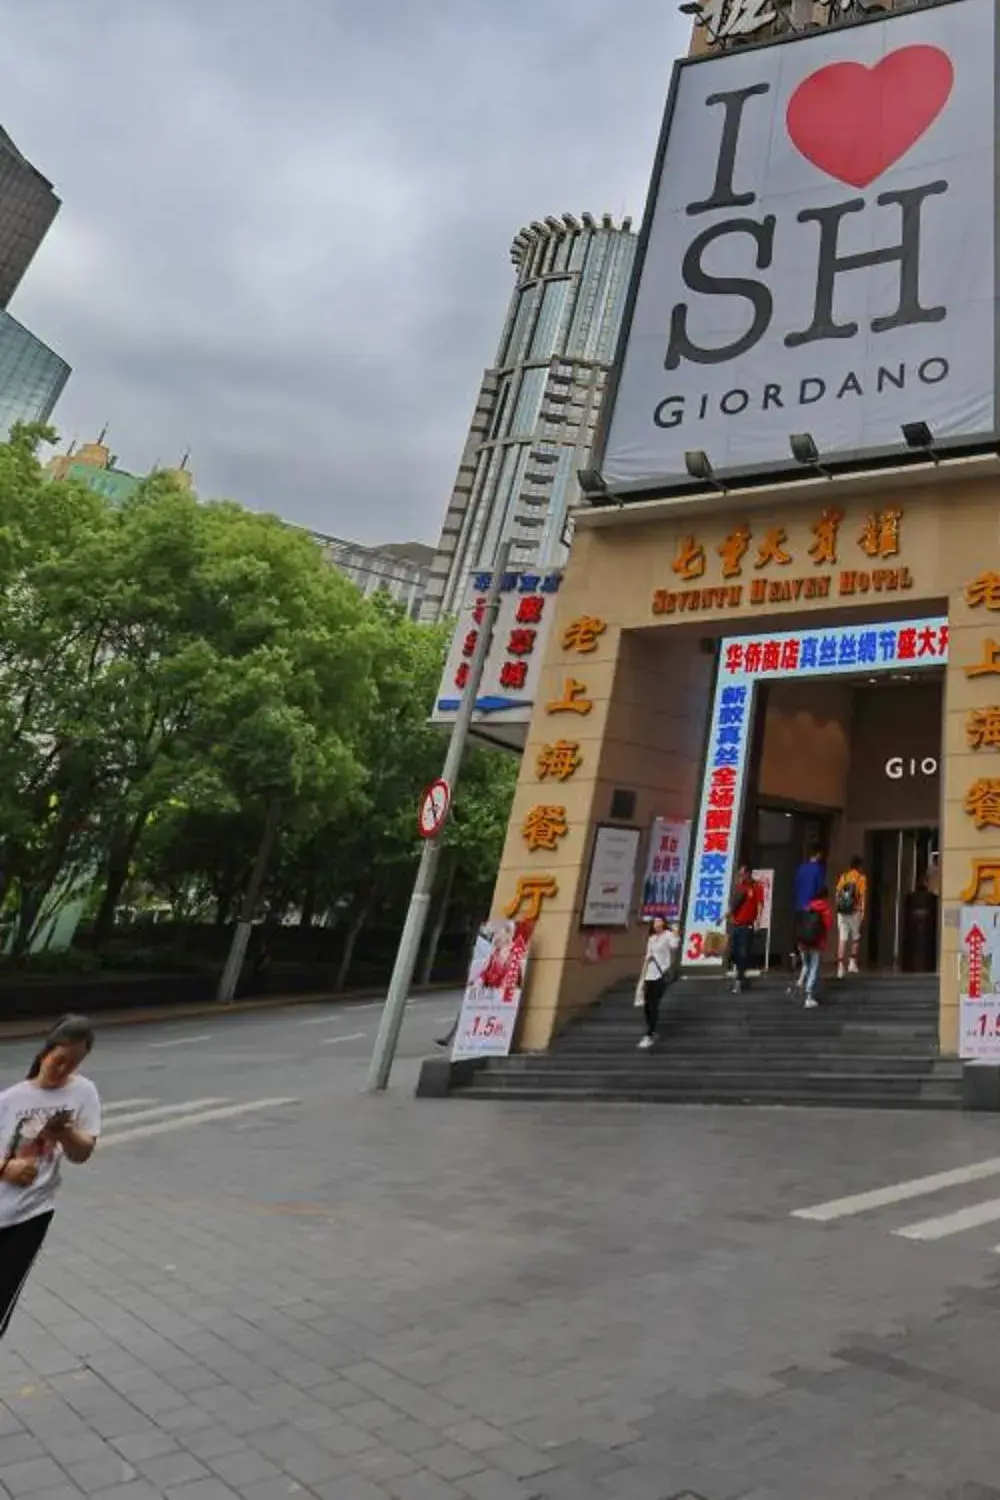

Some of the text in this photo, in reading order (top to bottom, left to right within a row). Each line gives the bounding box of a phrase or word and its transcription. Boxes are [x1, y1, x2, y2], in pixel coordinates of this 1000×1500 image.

[686, 83, 770, 216] I
[664, 180, 948, 371] SH
[653, 358, 950, 429] GIORDANO
[507, 615, 606, 920] 老上海餐厅
